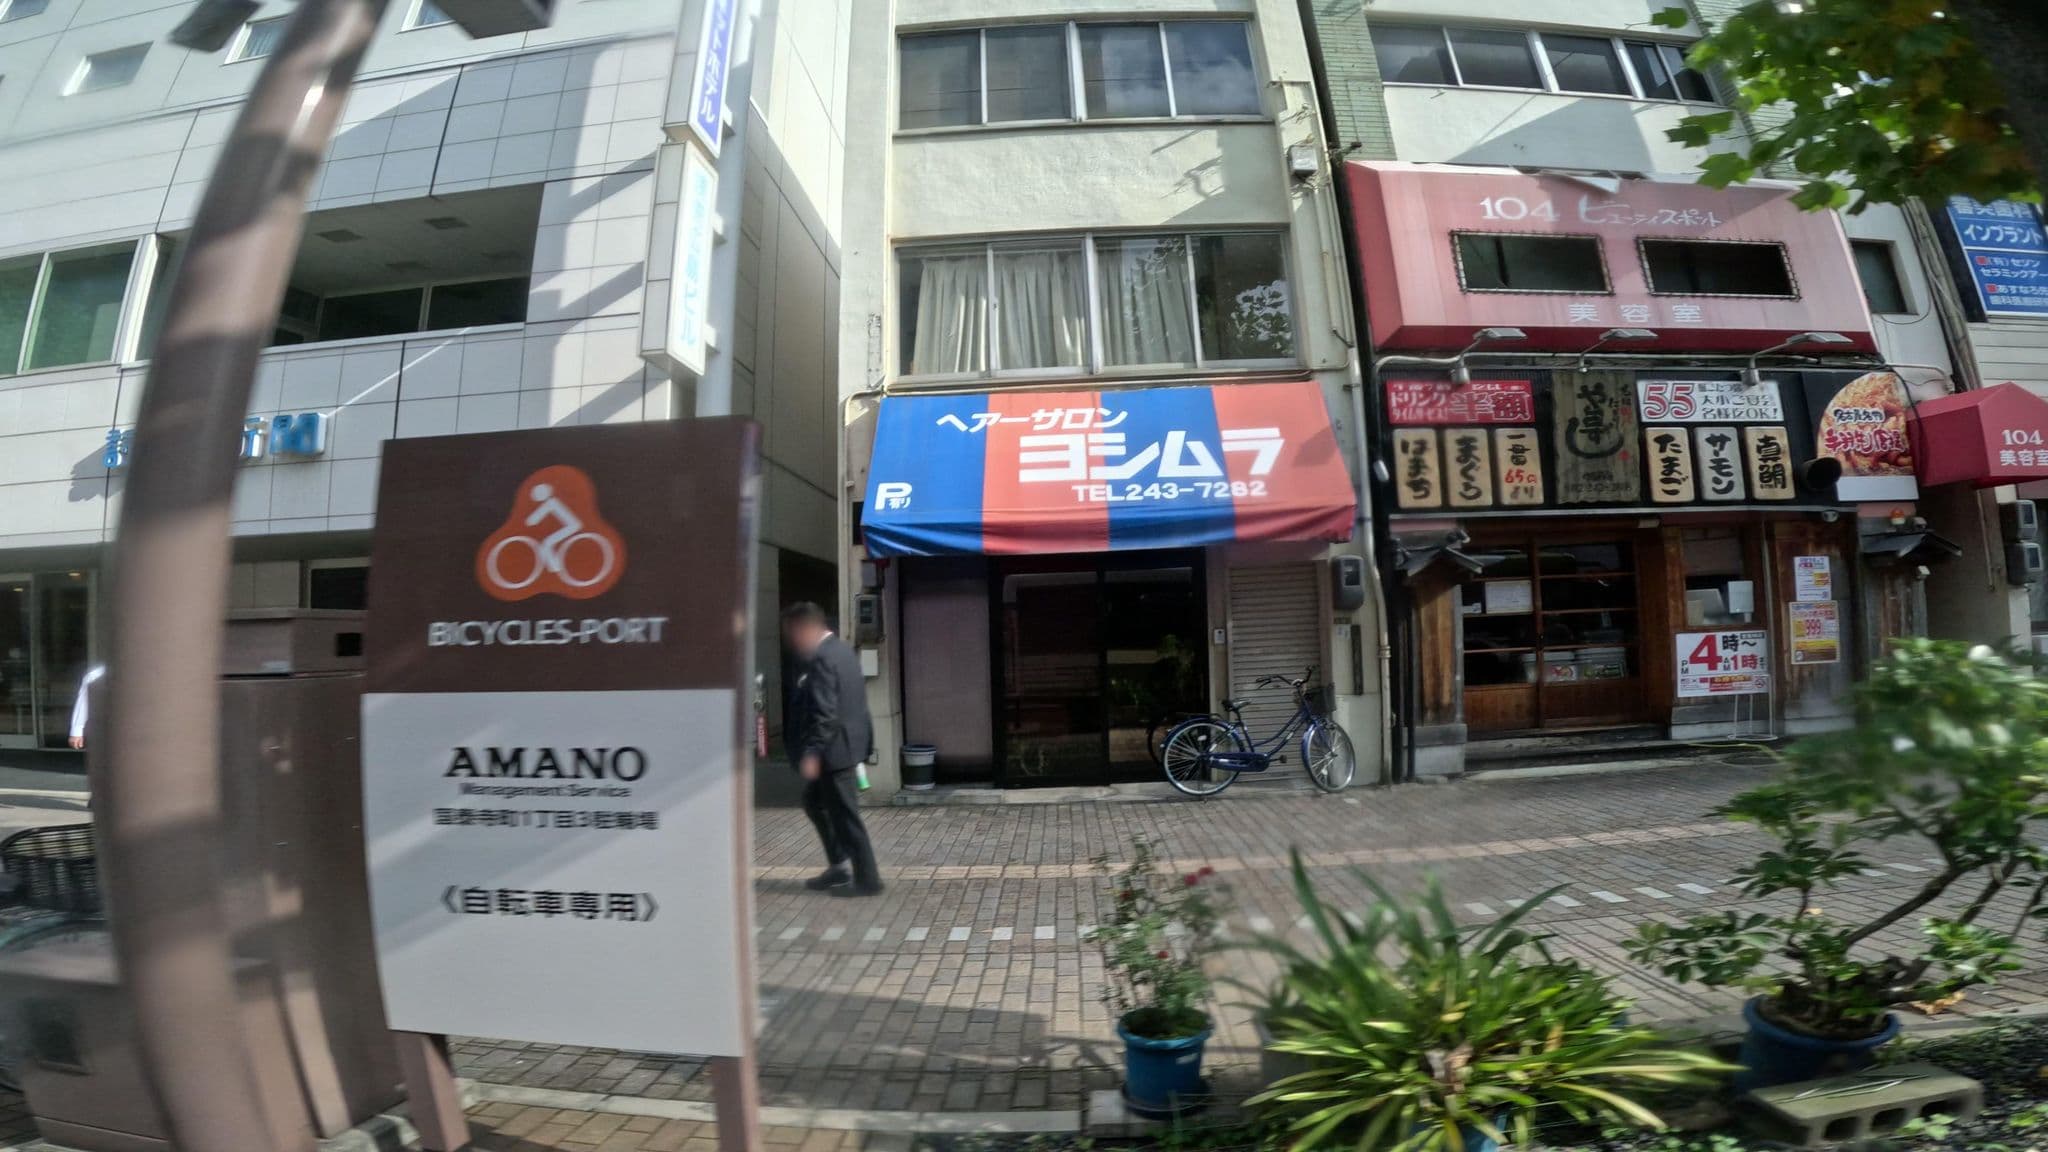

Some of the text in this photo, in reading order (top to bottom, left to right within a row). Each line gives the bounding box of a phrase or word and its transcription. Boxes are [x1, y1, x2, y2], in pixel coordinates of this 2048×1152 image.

[1480, 196, 1560, 222] 104
[1568, 303, 1705, 324] 美容室
[1391, 391, 1447, 408] ドリンク
[1643, 383, 1696, 419] 55
[936, 407, 1128, 433] ヘアーサロン
[2002, 429, 2044, 446] 104
[1018, 427, 1286, 483] ヨシムラ
[1401, 439, 1432, 500] はまち
[1456, 435, 1483, 500] まぐろ
[1653, 433, 1689, 496] たまご
[1705, 433, 1736, 495] サーモン
[443, 746, 648, 781] AMANO
[459, 782, 633, 799] Management Service
